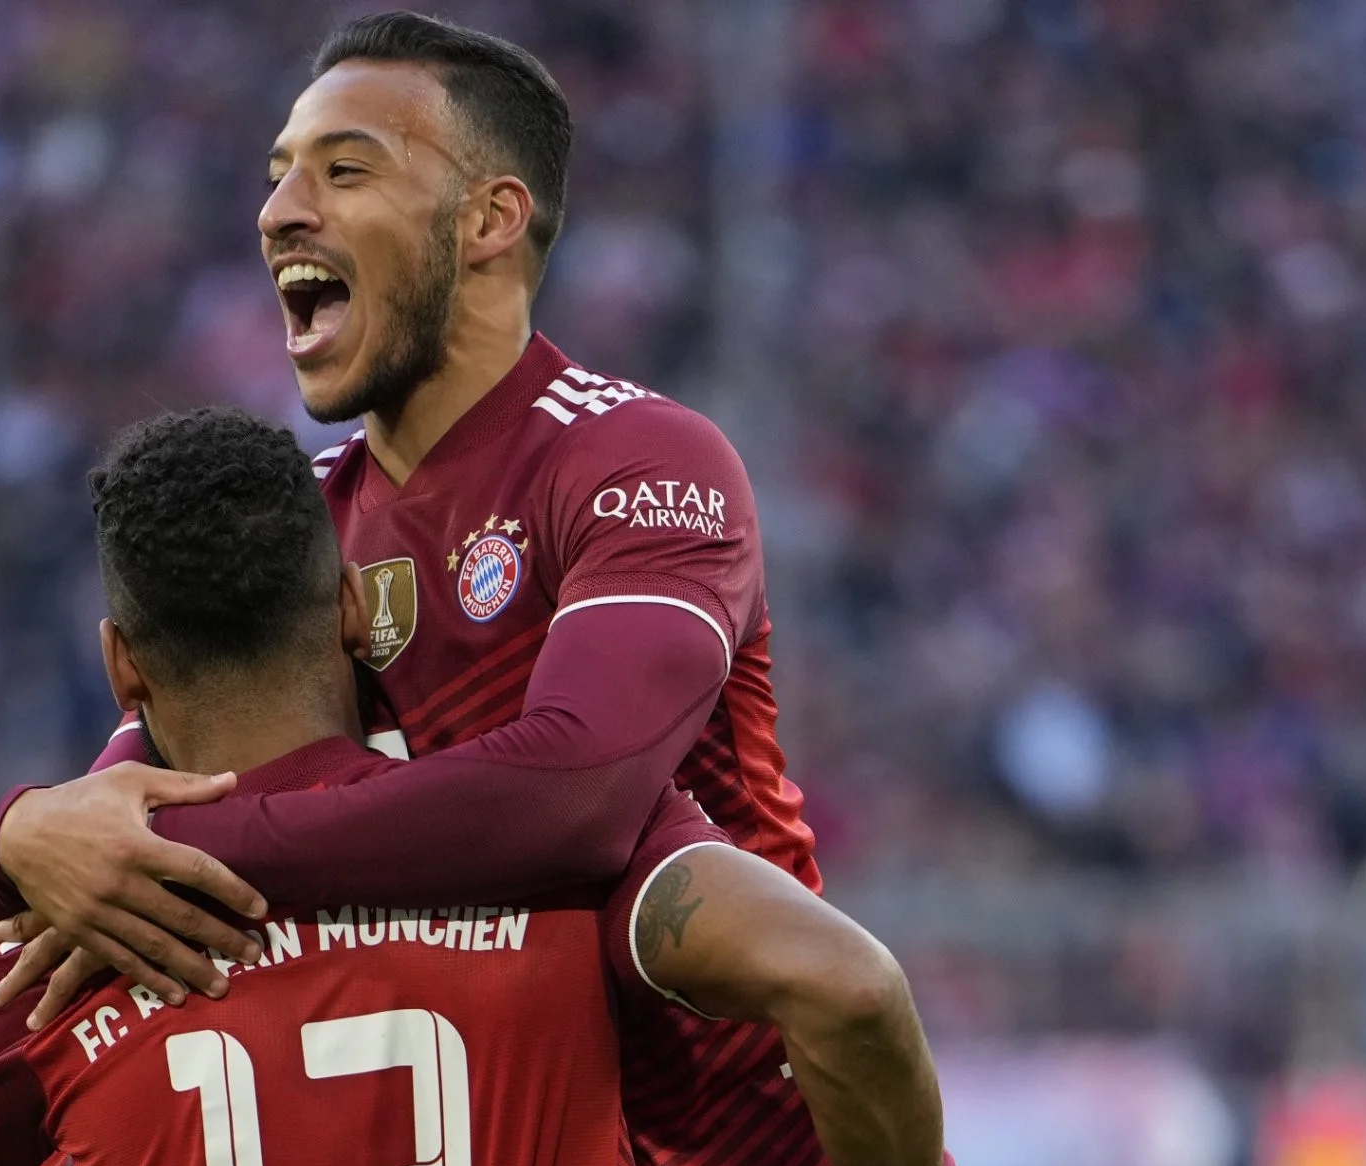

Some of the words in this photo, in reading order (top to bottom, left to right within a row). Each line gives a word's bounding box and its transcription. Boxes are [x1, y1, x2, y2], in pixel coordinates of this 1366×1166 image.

[593, 480, 725, 524] QATAR
[629, 508, 724, 539] AIRWAYS
[462, 561, 475, 581] FC
[473, 540, 514, 567] BAYERN
[463, 578, 513, 617] MÜNCHEN
[370, 648, 390, 658] 2020
[71, 1005, 129, 1064] FC
